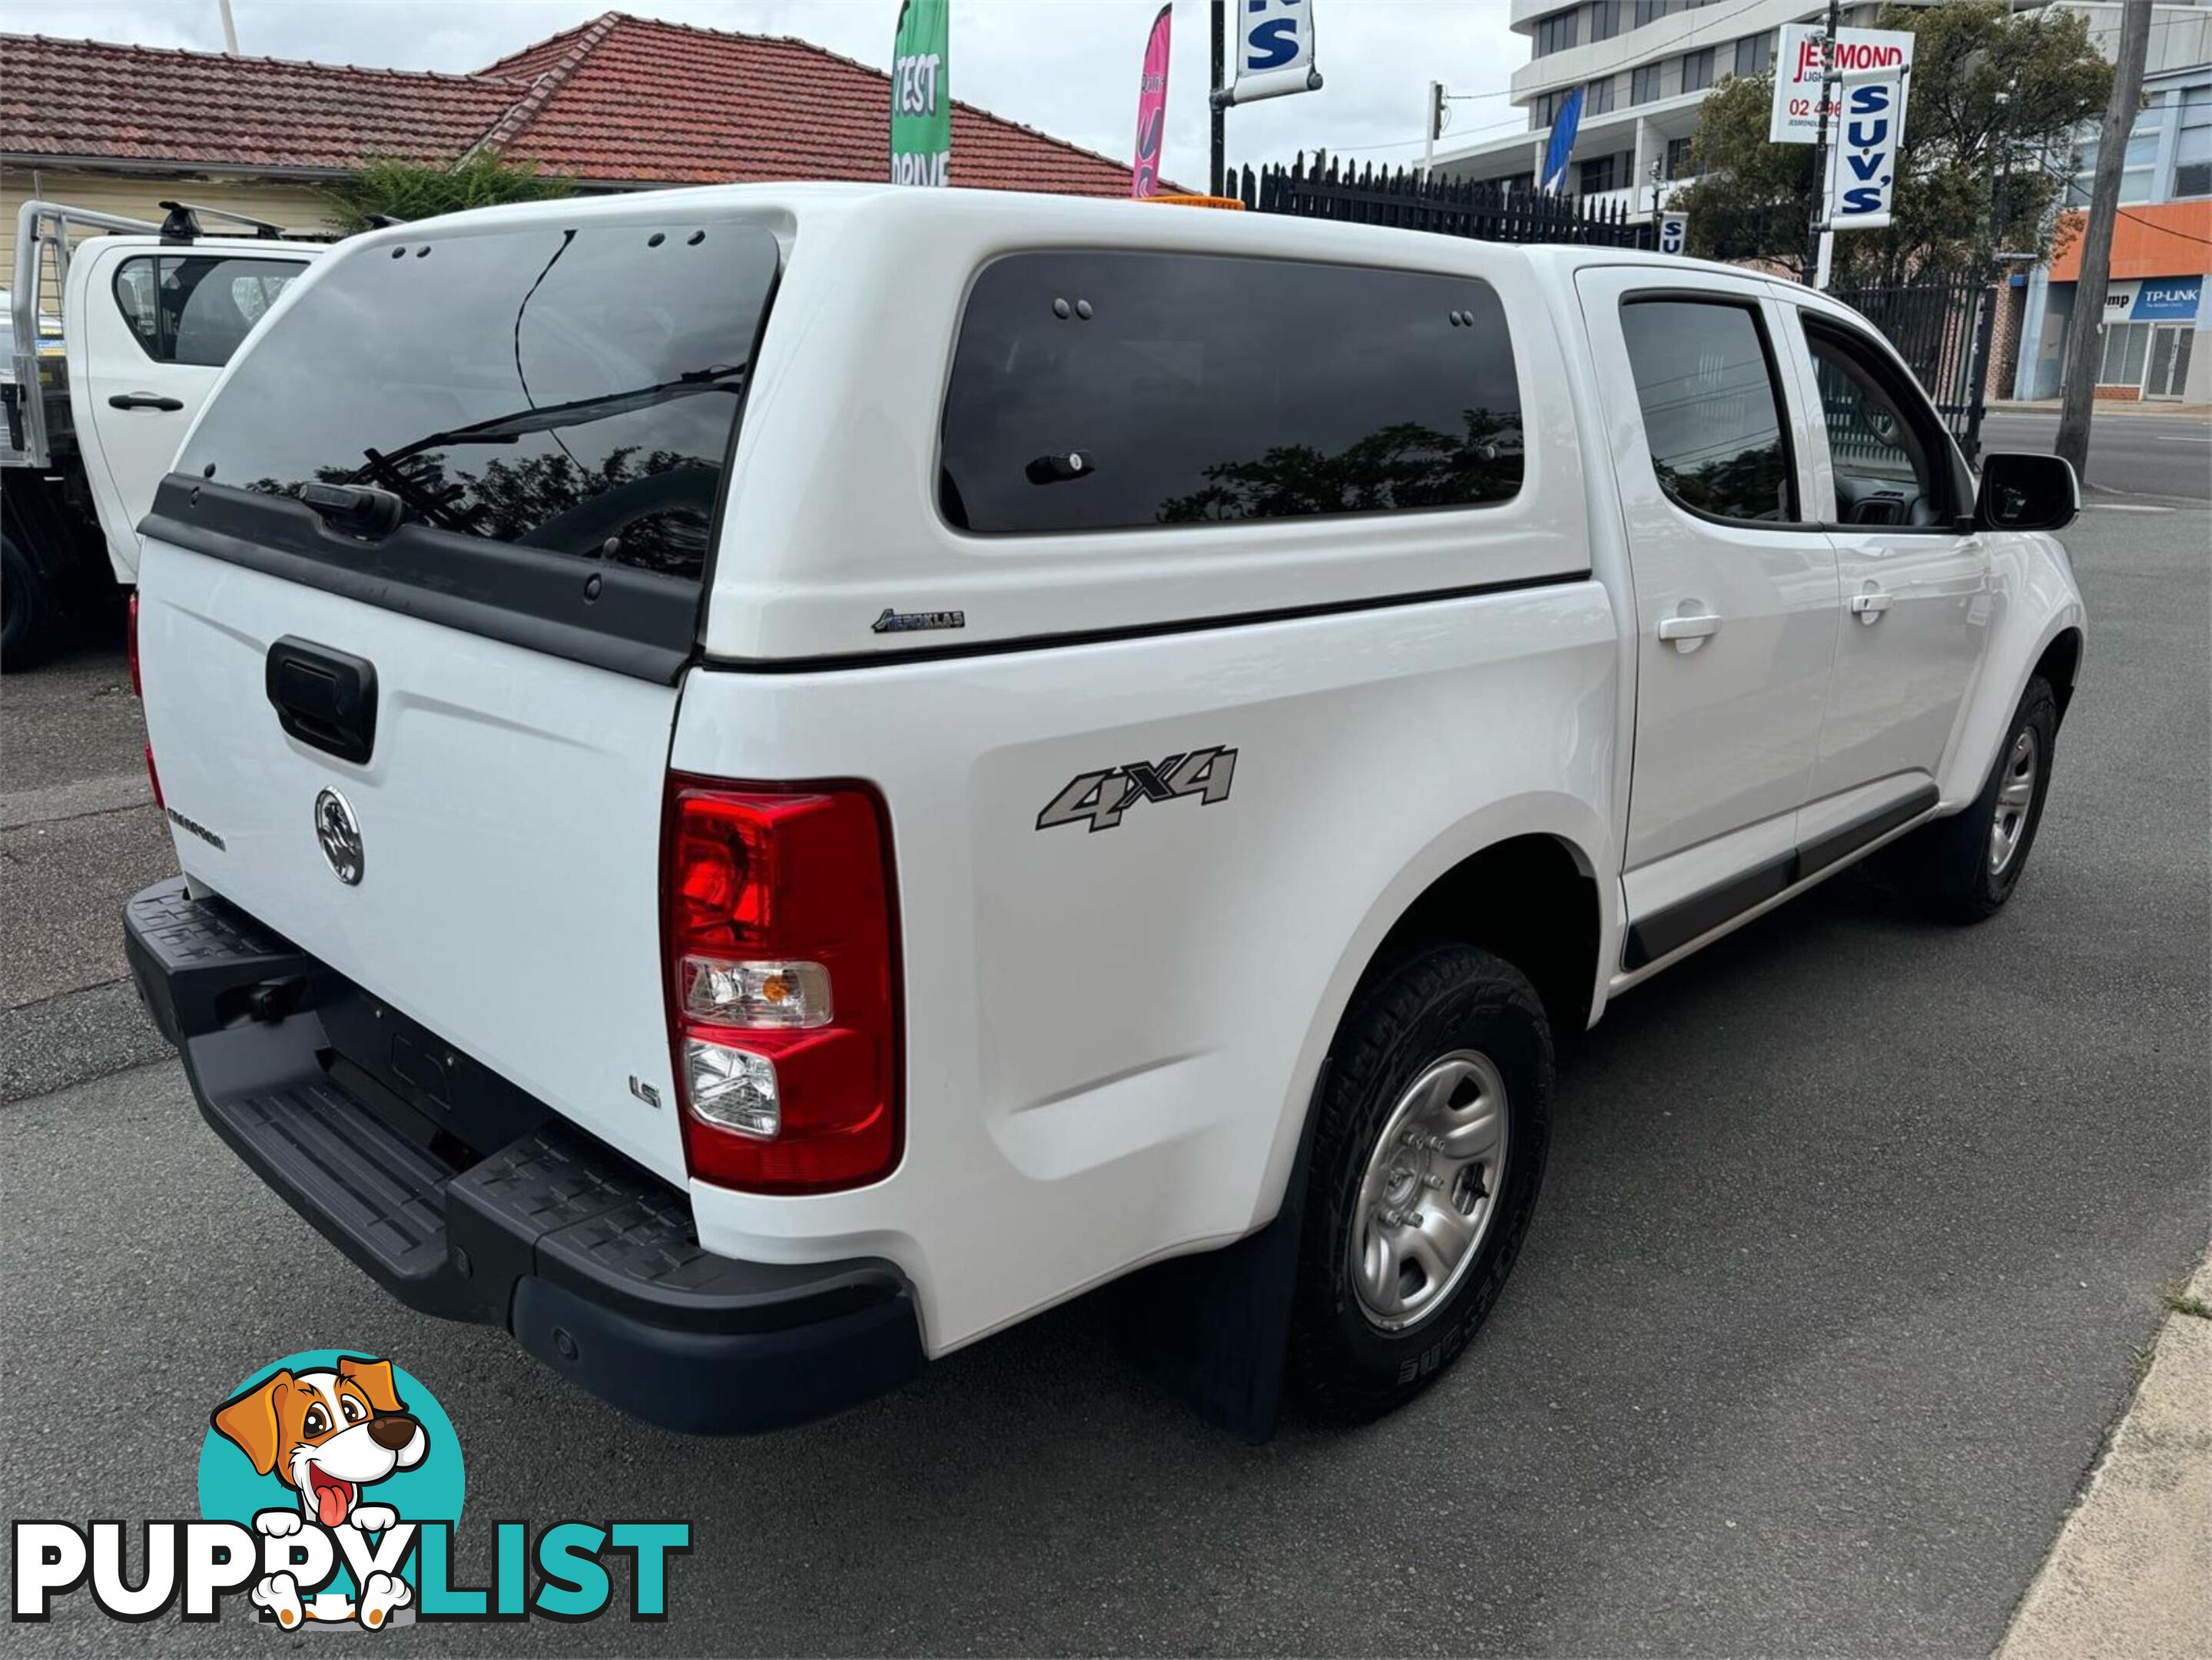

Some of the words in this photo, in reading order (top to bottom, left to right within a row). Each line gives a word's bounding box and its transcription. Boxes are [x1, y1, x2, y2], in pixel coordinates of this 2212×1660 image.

[895, 53, 940, 113] TEST
[1789, 98, 1809, 116] 02
[2146, 290, 2199, 301] TP-LINK
